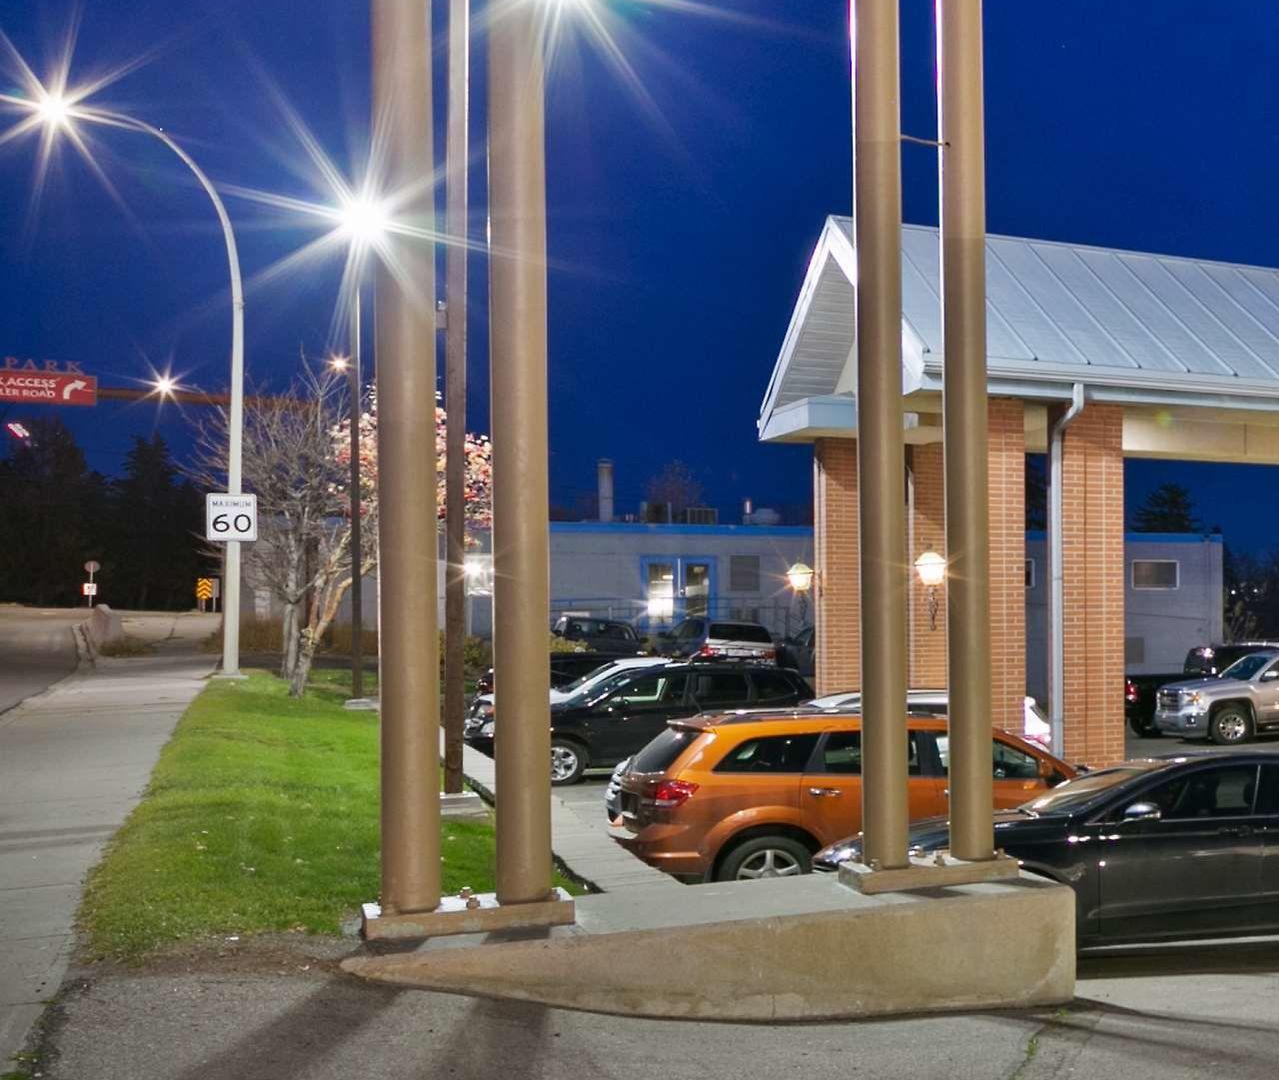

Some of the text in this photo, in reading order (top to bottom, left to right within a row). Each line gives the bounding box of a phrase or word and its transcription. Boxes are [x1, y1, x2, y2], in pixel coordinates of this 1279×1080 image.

[5, 356, 85, 376] PARK
[7, 377, 57, 388] ACCESS
[22, 388, 56, 398] ROAD
[212, 514, 251, 533] 60
